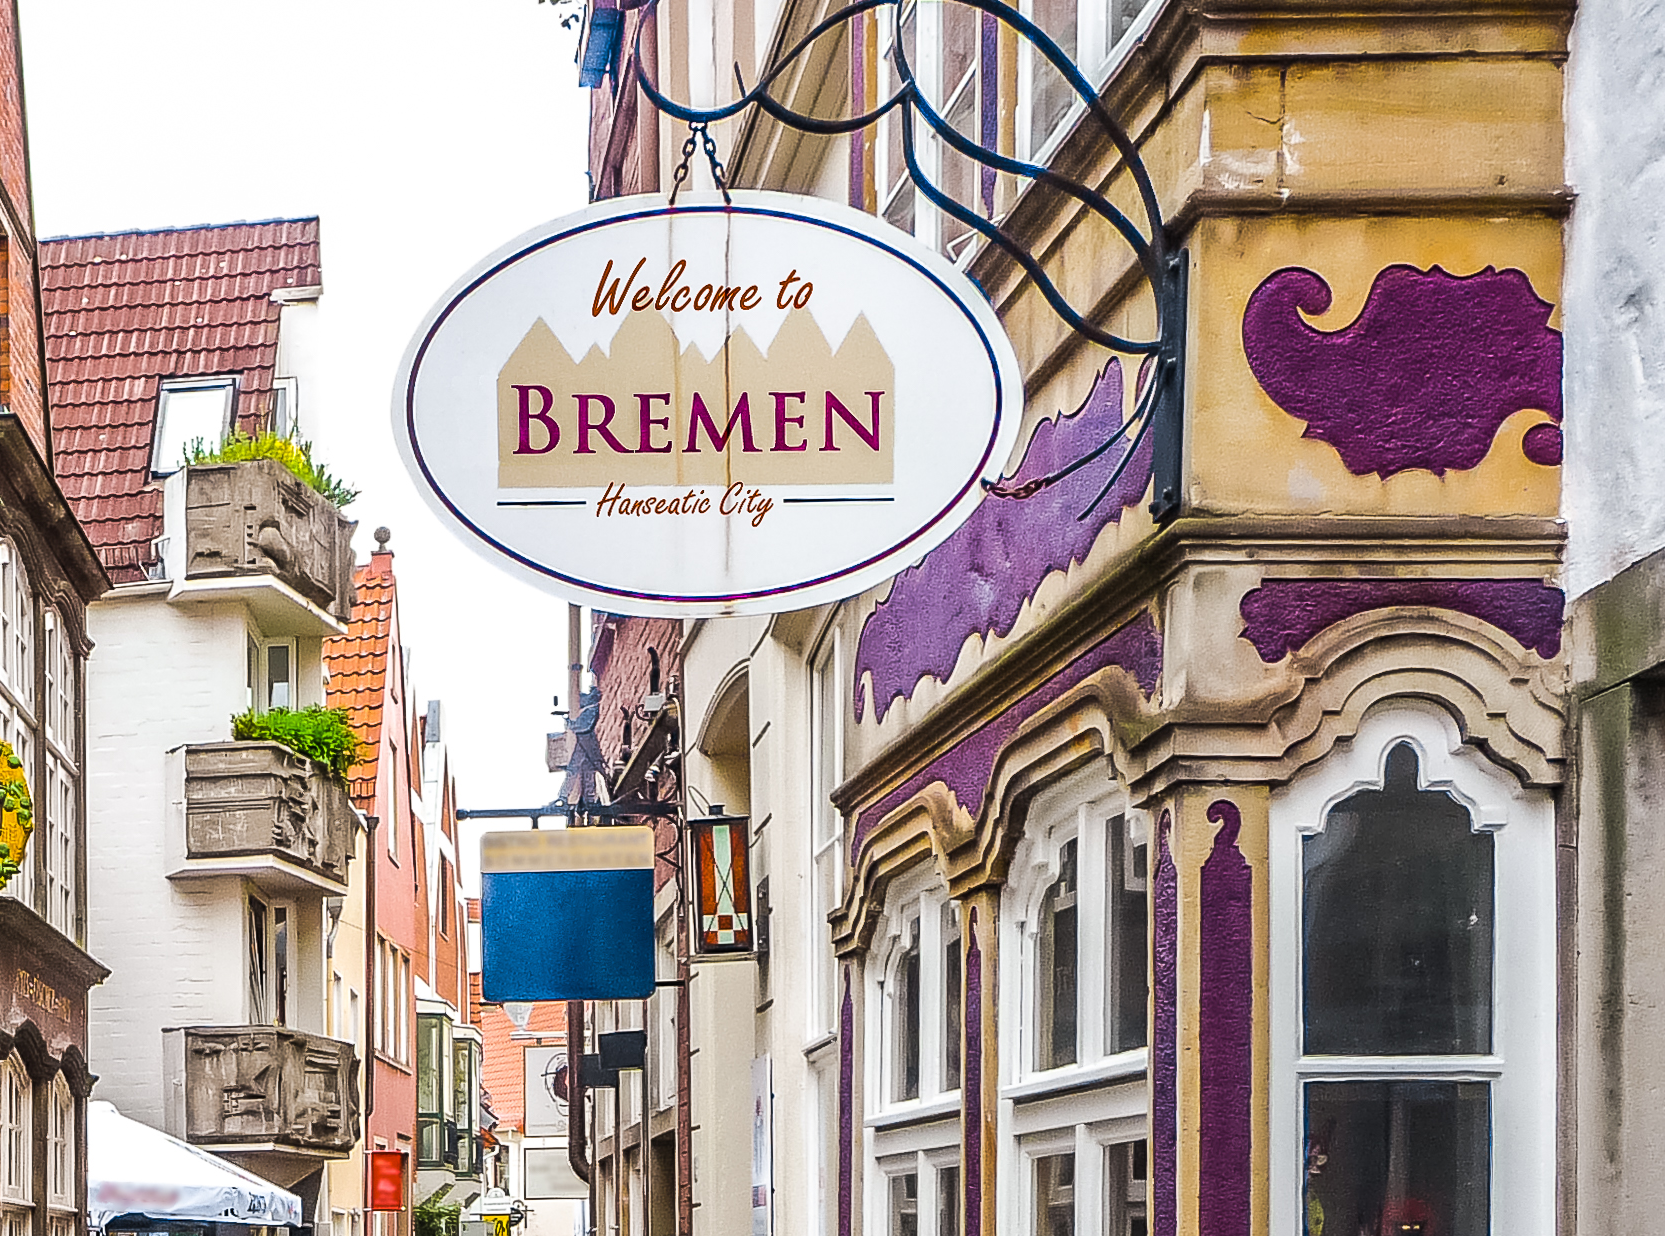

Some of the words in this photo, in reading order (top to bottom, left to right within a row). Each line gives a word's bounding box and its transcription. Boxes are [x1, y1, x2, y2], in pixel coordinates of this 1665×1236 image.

[591, 256, 763, 318] Welcome
[777, 269, 814, 310] to
[510, 383, 886, 455] BREMEN
[596, 481, 712, 518] Hanseatic
[719, 481, 775, 528] City
